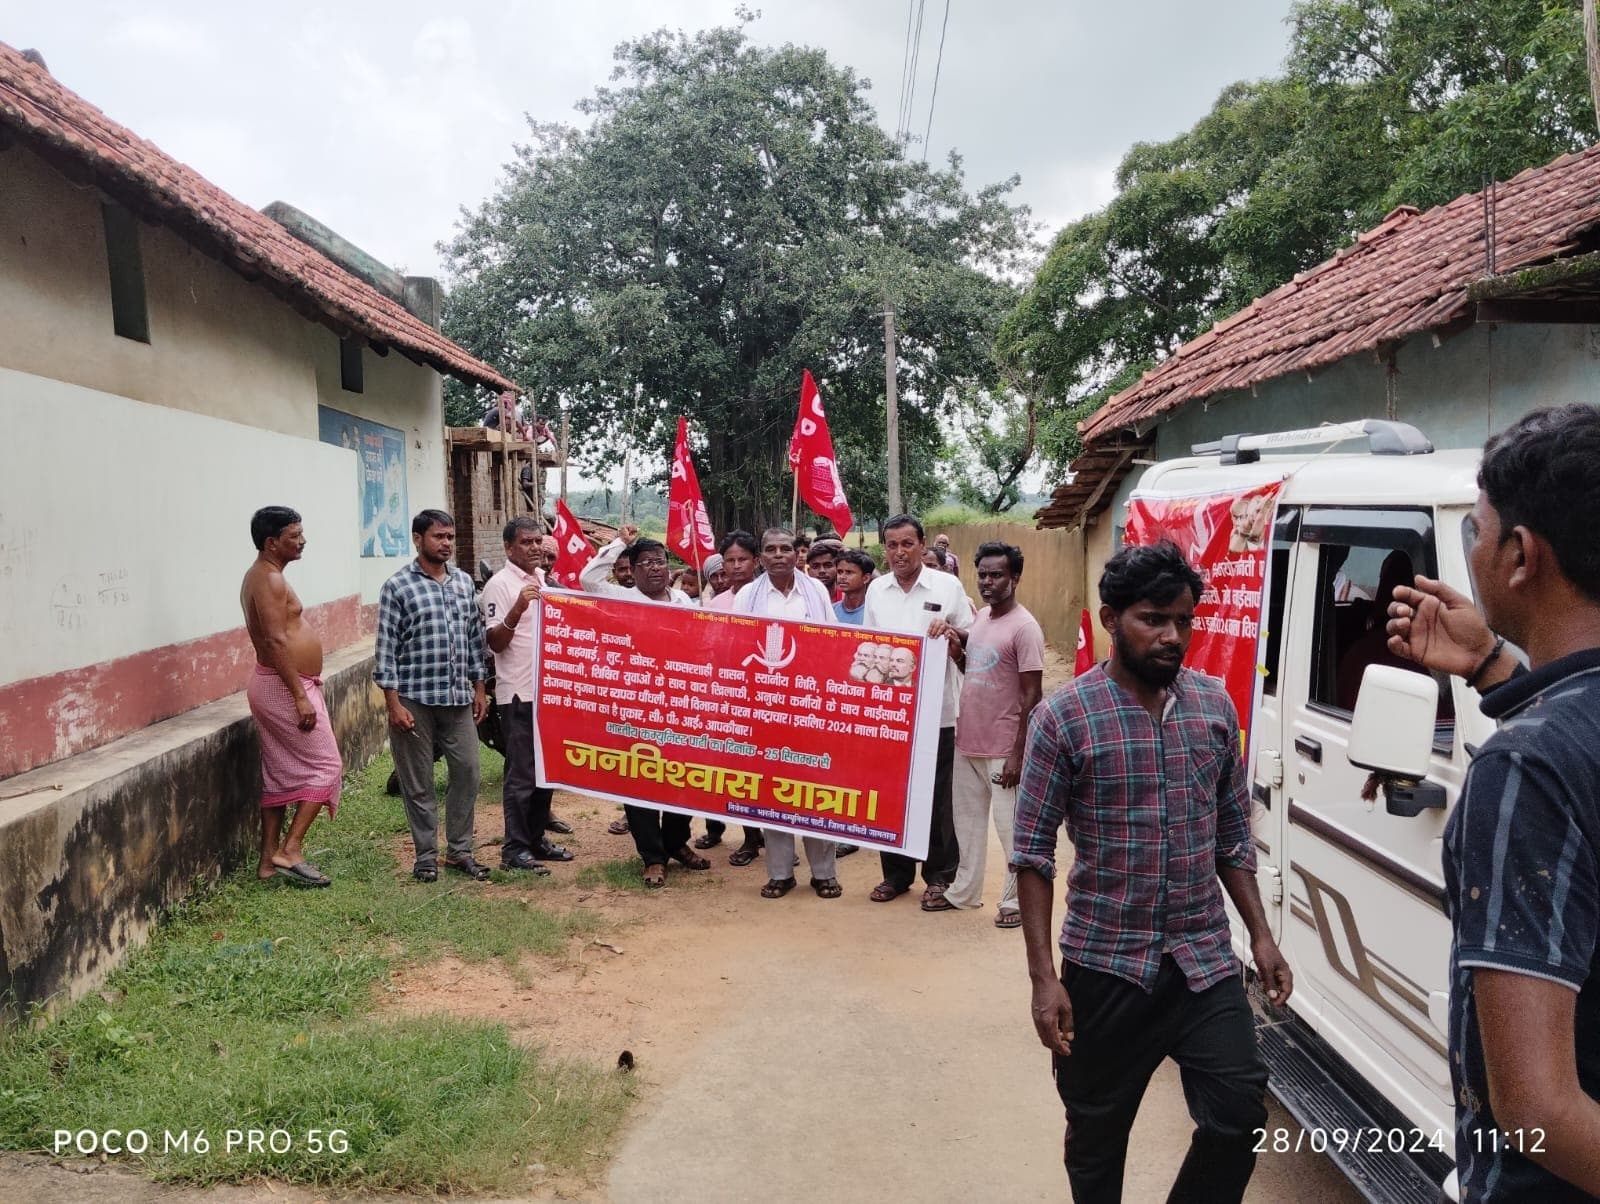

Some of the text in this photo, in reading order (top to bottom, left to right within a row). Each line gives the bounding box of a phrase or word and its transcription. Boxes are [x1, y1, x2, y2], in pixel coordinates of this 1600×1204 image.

[488, 603, 496, 617] 3
[545, 604, 564, 621] प्रिय,
[591, 664, 619, 680] शिक्षित
[623, 671, 651, 686] युवाओं
[654, 672, 665, 687] के
[668, 677, 686, 690] साथ
[755, 690, 786, 706] अनुबंध
[826, 698, 837, 712] के
[841, 702, 860, 716] साथ
[664, 660, 713, 677] अफसरशाही
[718, 667, 748, 684] शासन,
[755, 672, 789, 687] स्थानीय
[826, 679, 865, 698] नियोजन
[899, 692, 913, 705] पर
[543, 673, 573, 691] रोजगार
[574, 681, 595, 696] सृजन
[597, 686, 608, 698] पर
[670, 694, 689, 709] सभी
[690, 696, 719, 713] विभाग
[720, 701, 730, 715] में
[793, 713, 826, 730] इसलिए
[827, 720, 852, 734] 2024
[854, 723, 878, 738] नाला
[879, 724, 909, 742] विधान
[543, 693, 562, 705] सभा
[563, 694, 572, 707] के
[573, 699, 597, 712] जनता
[599, 703, 610, 715] का
[611, 701, 618, 717] है
[619, 707, 645, 722] पुकार,
[606, 721, 638, 738] भारतीय
[688, 733, 709, 750] पार्टी
[709, 738, 724, 752] का
[724, 737, 758, 757] दिनांक
[764, 747, 779, 761] 25
[780, 746, 819, 767] सितम्बर
[819, 752, 831, 769] से
[562, 739, 878, 821] जनविश्वास यात्रा।
[757, 808, 780, 819] भारतीय
